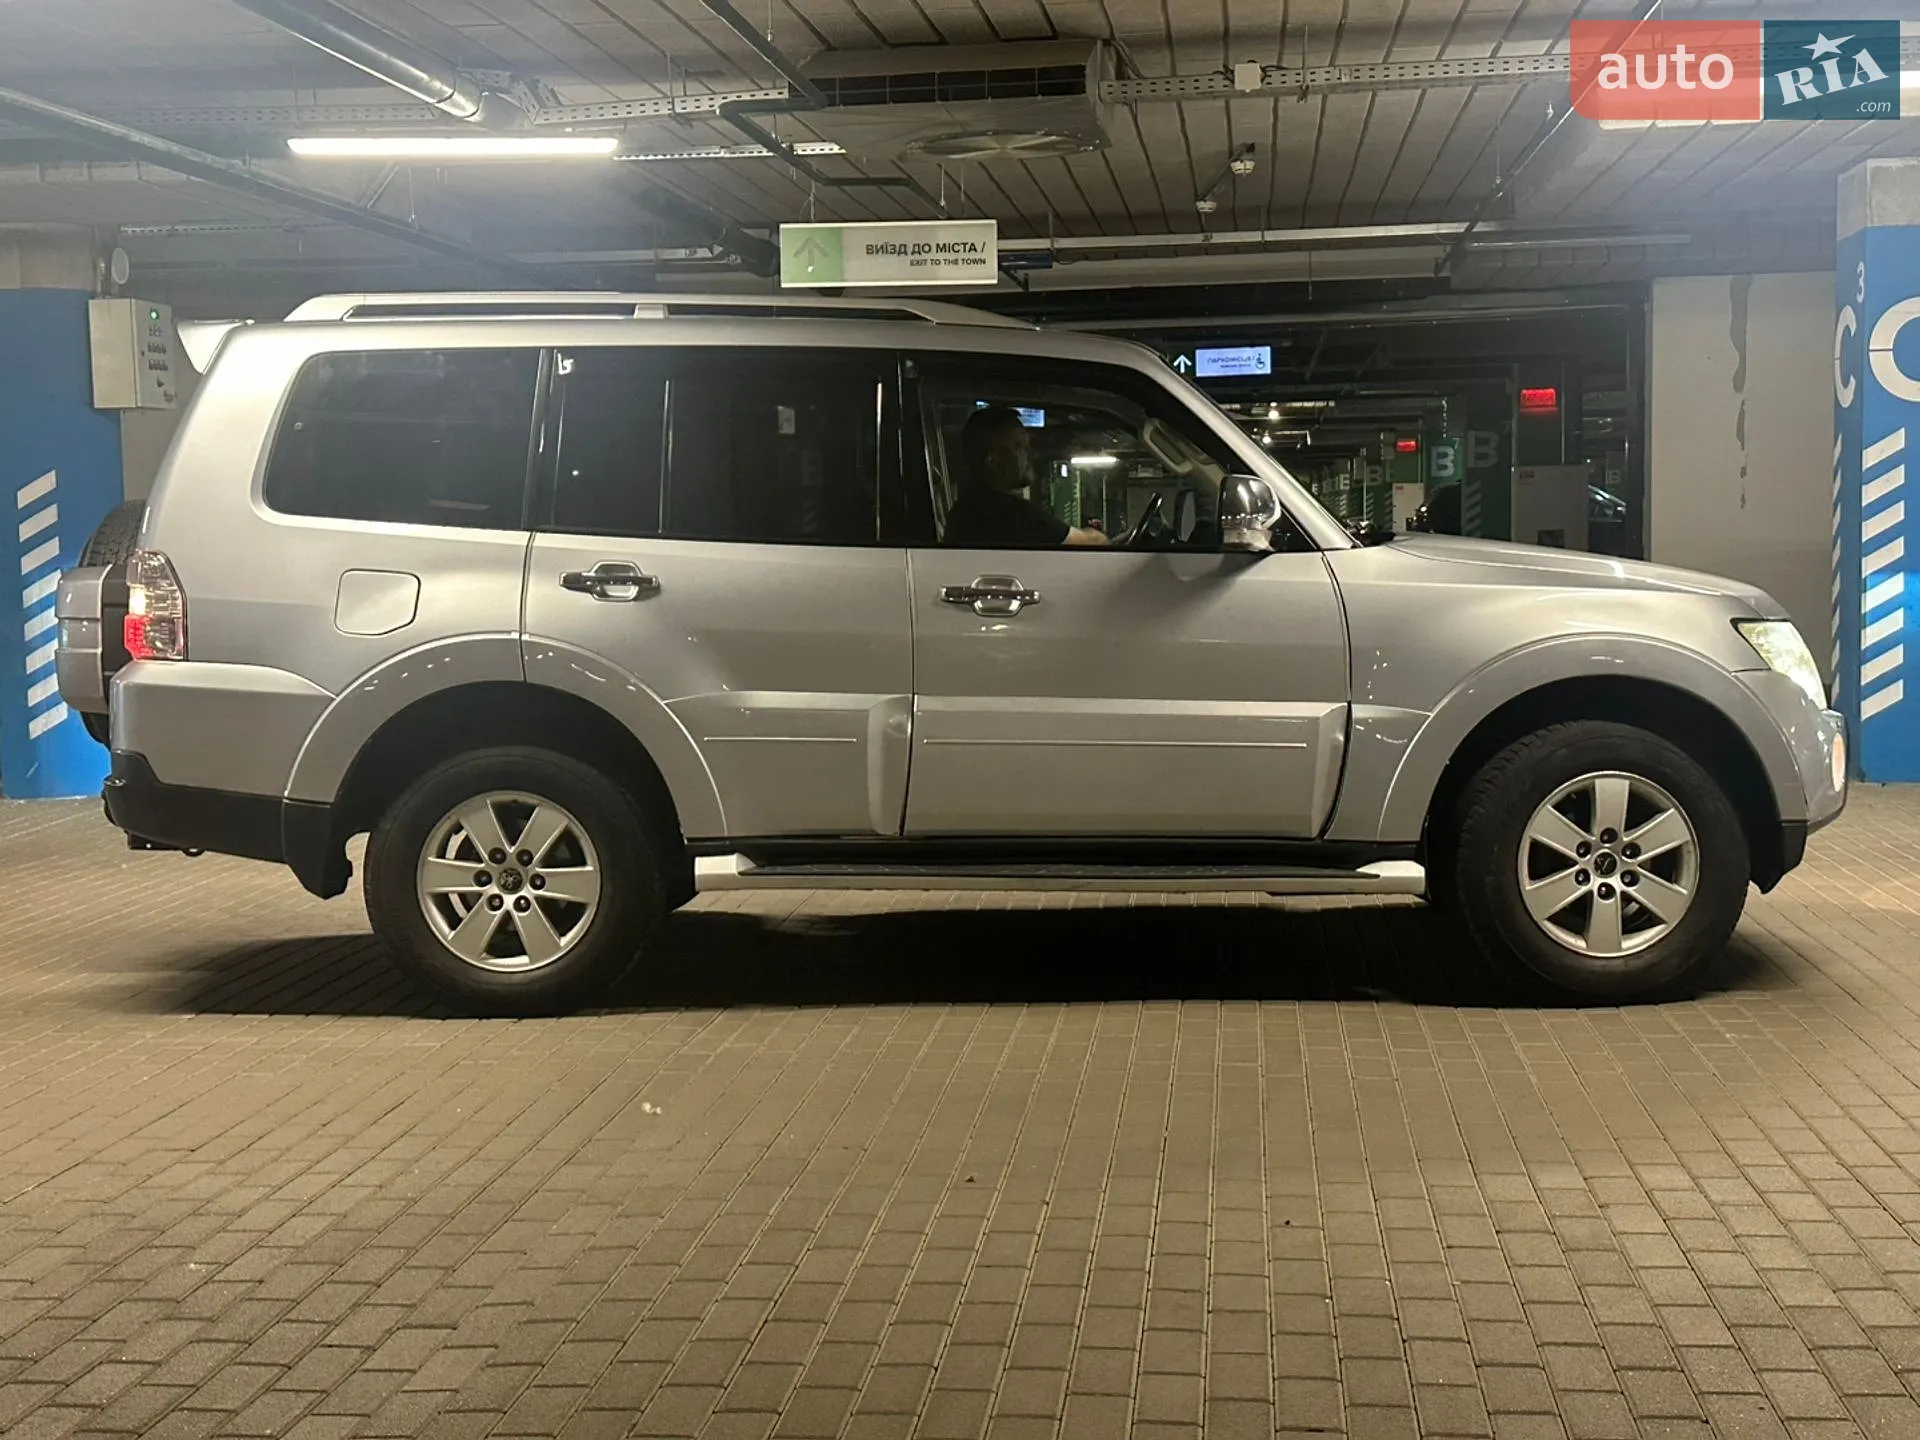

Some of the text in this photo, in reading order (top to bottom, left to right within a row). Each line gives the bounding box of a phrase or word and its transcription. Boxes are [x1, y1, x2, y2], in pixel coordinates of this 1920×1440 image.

[866, 242, 908, 256] ВИЇЗД
[911, 243, 931, 255] ДО
[935, 241, 977, 253] МІСТА
[910, 257, 986, 267] EXIT TO THE TOWN
[1856, 261, 1865, 303] 3
[1431, 446, 1454, 476] B
[1467, 429, 1499, 468] B
